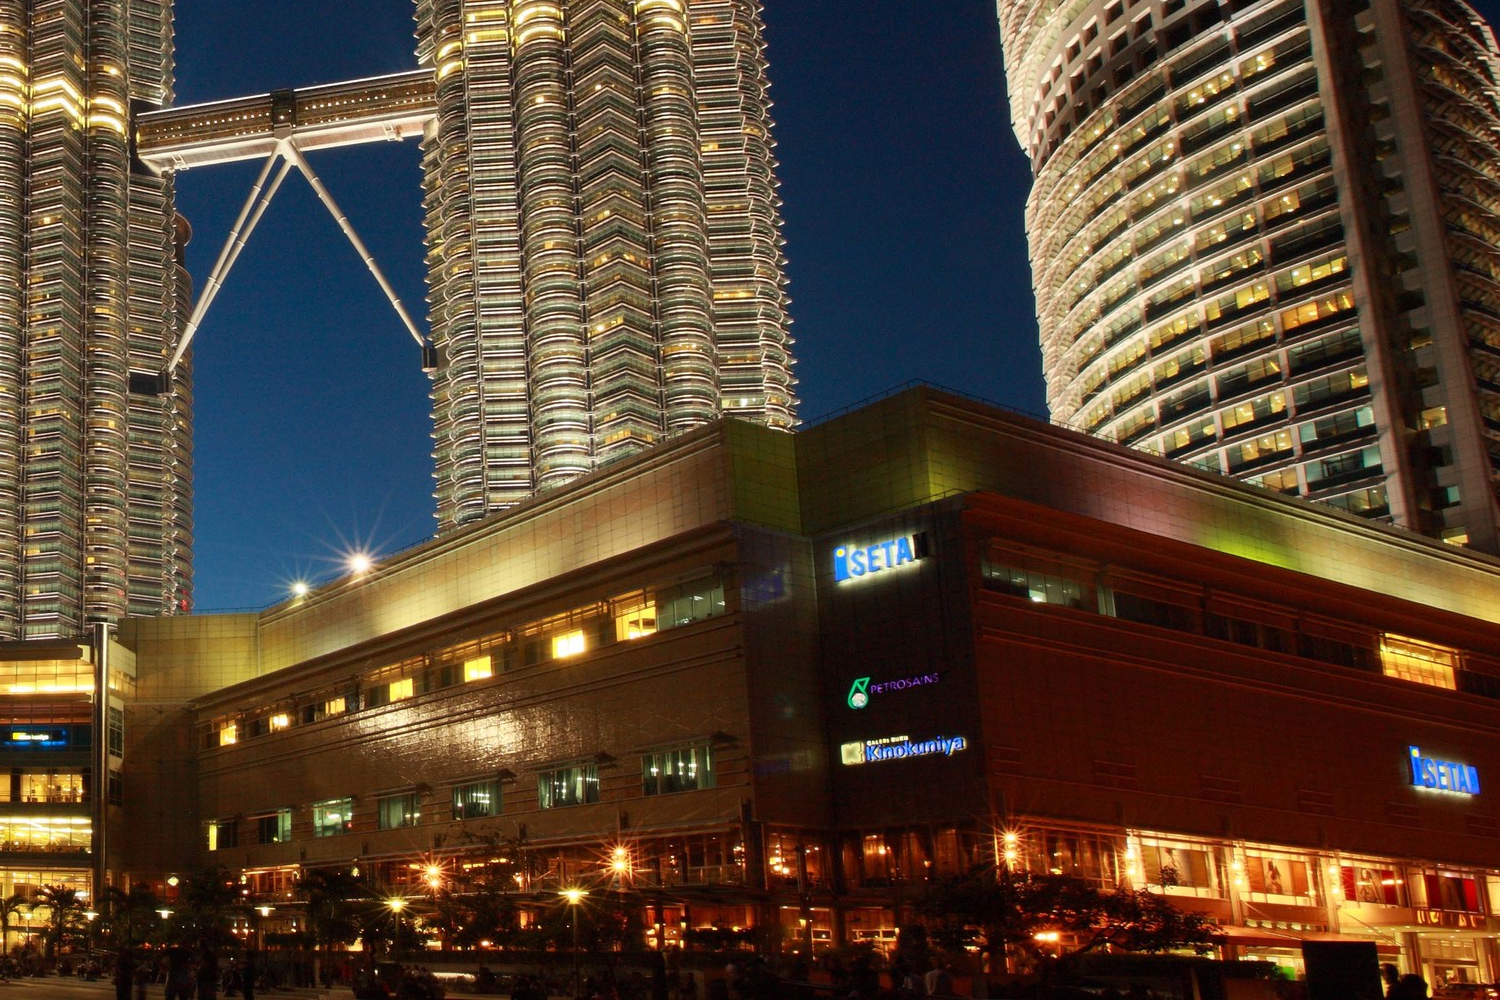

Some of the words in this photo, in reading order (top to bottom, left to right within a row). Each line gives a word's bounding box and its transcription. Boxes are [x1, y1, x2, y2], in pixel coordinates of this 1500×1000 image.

[833, 532, 928, 583] iSETA
[870, 672, 940, 694] PETROSAINS
[866, 736, 965, 761] Kinokuniya
